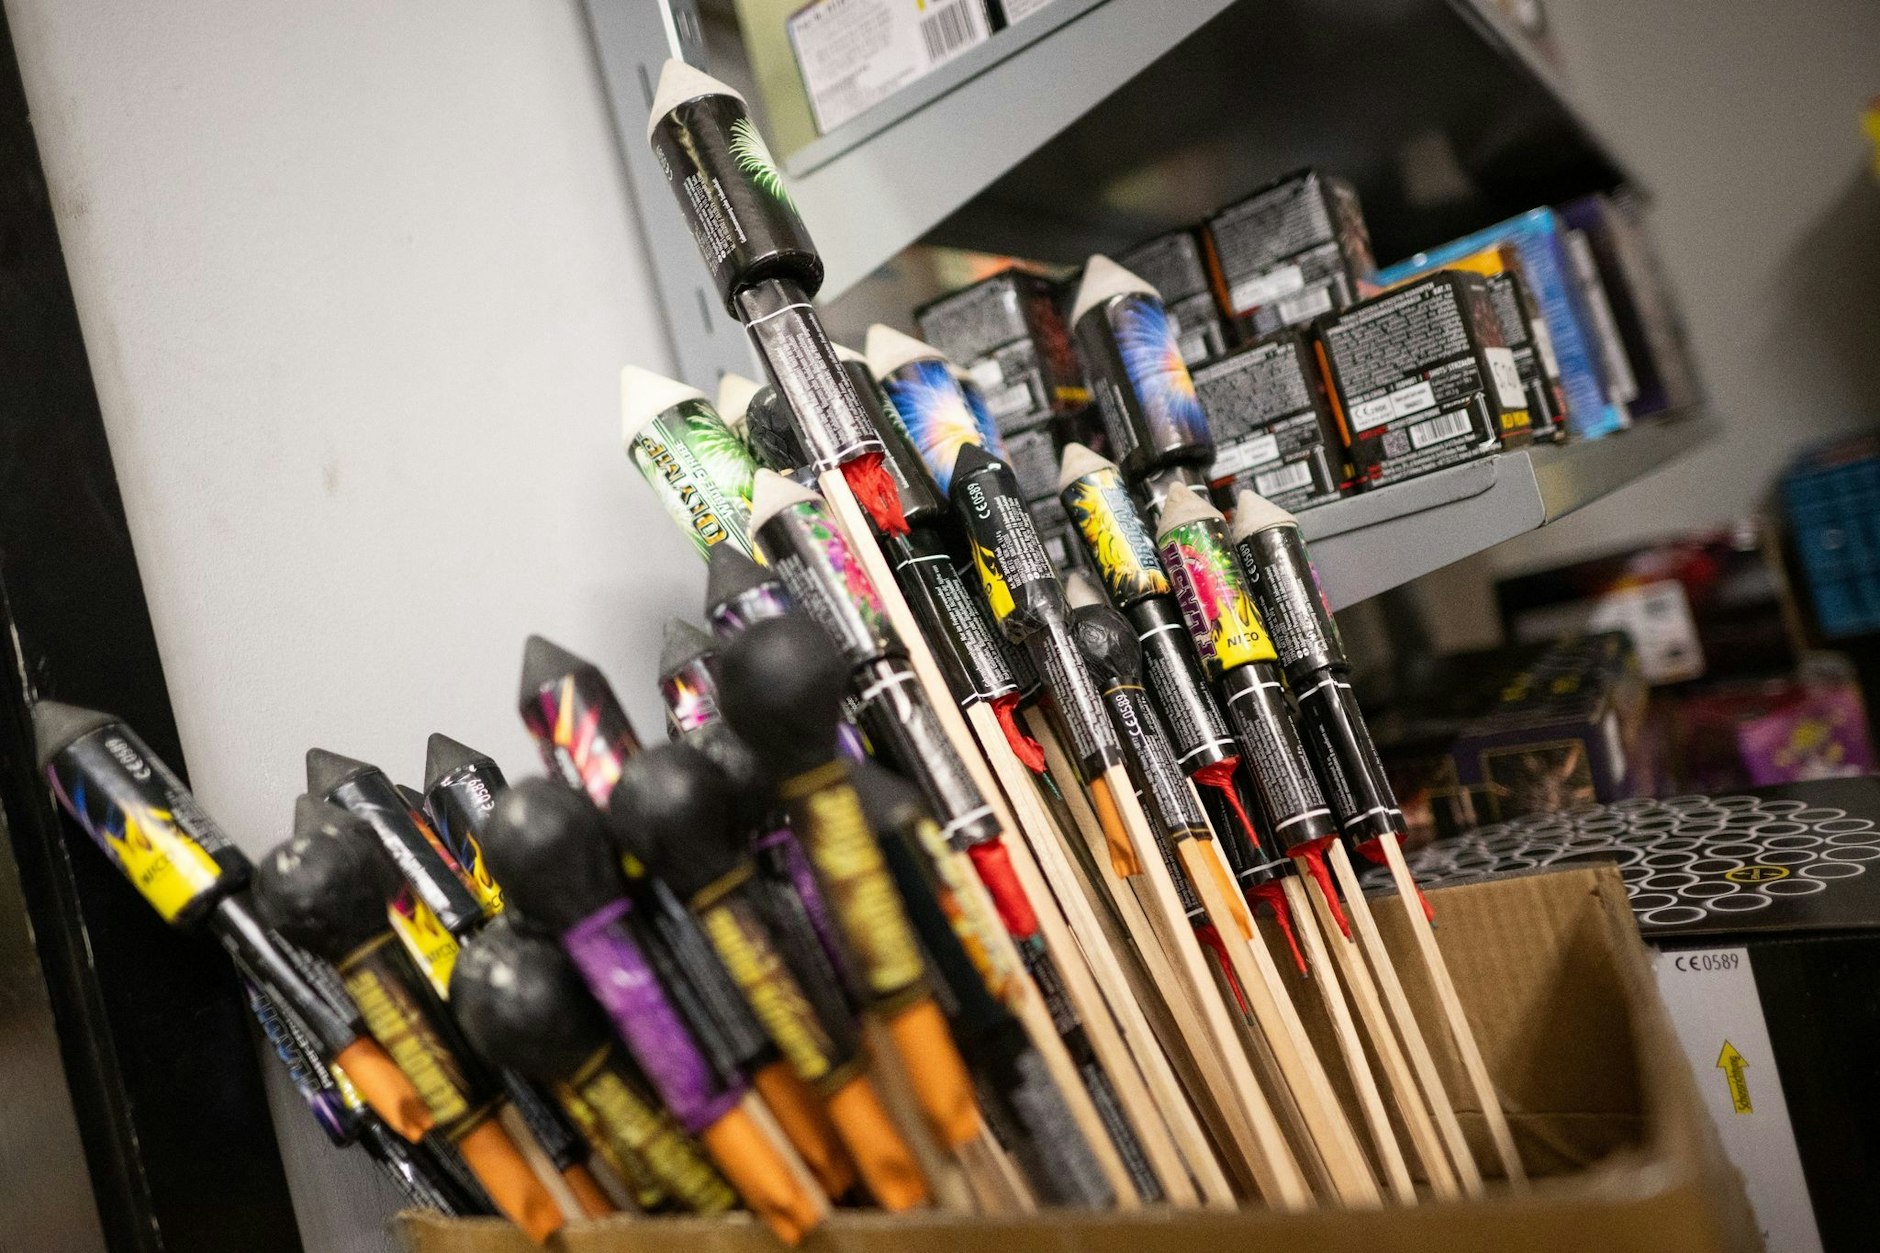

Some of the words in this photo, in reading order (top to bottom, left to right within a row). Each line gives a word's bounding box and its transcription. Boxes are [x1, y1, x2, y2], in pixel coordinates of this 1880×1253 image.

[638, 431, 730, 548] OLYMP
[1100, 483, 1160, 571] BROCADE
[1226, 630, 1261, 649] NICO
[1675, 953, 1740, 972] CE0589
